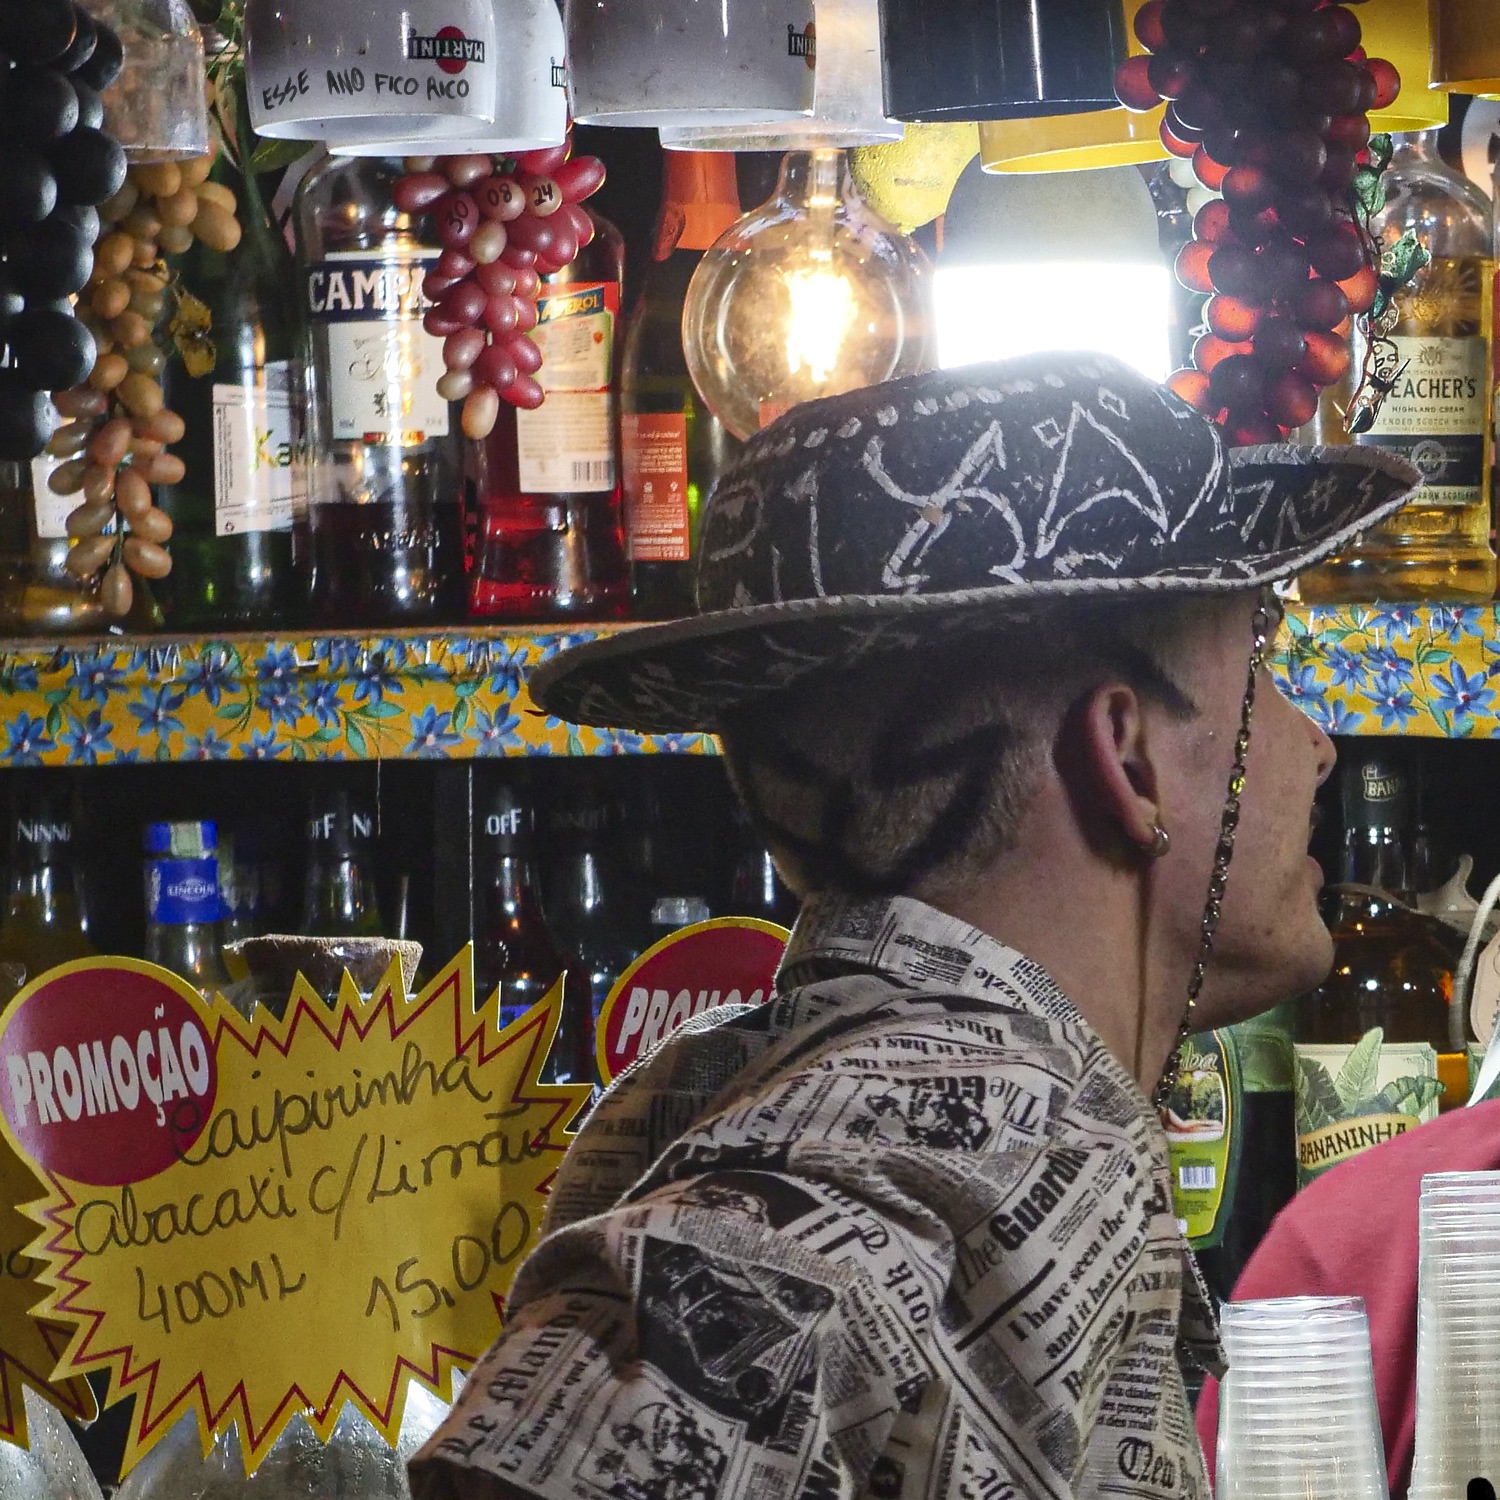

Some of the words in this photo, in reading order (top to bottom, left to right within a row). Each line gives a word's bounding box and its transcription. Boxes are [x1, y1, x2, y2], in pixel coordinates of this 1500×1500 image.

[411, 39, 484, 63] MARTINI
[262, 69, 310, 110] ESSE
[326, 66, 366, 95] ANO
[375, 73, 420, 96] FICO
[486, 181, 513, 207] 08
[308, 268, 434, 313] CAMPA
[1384, 376, 1477, 402] EACHER'S
[1377, 417, 1413, 426] LENDED
[8, 1006, 210, 1128] PROMOÇÃO
[1300, 1121, 1409, 1164] BANANINHA
[136, 1252, 307, 1336] 400ML
[366, 1202, 532, 1334] 15,00
